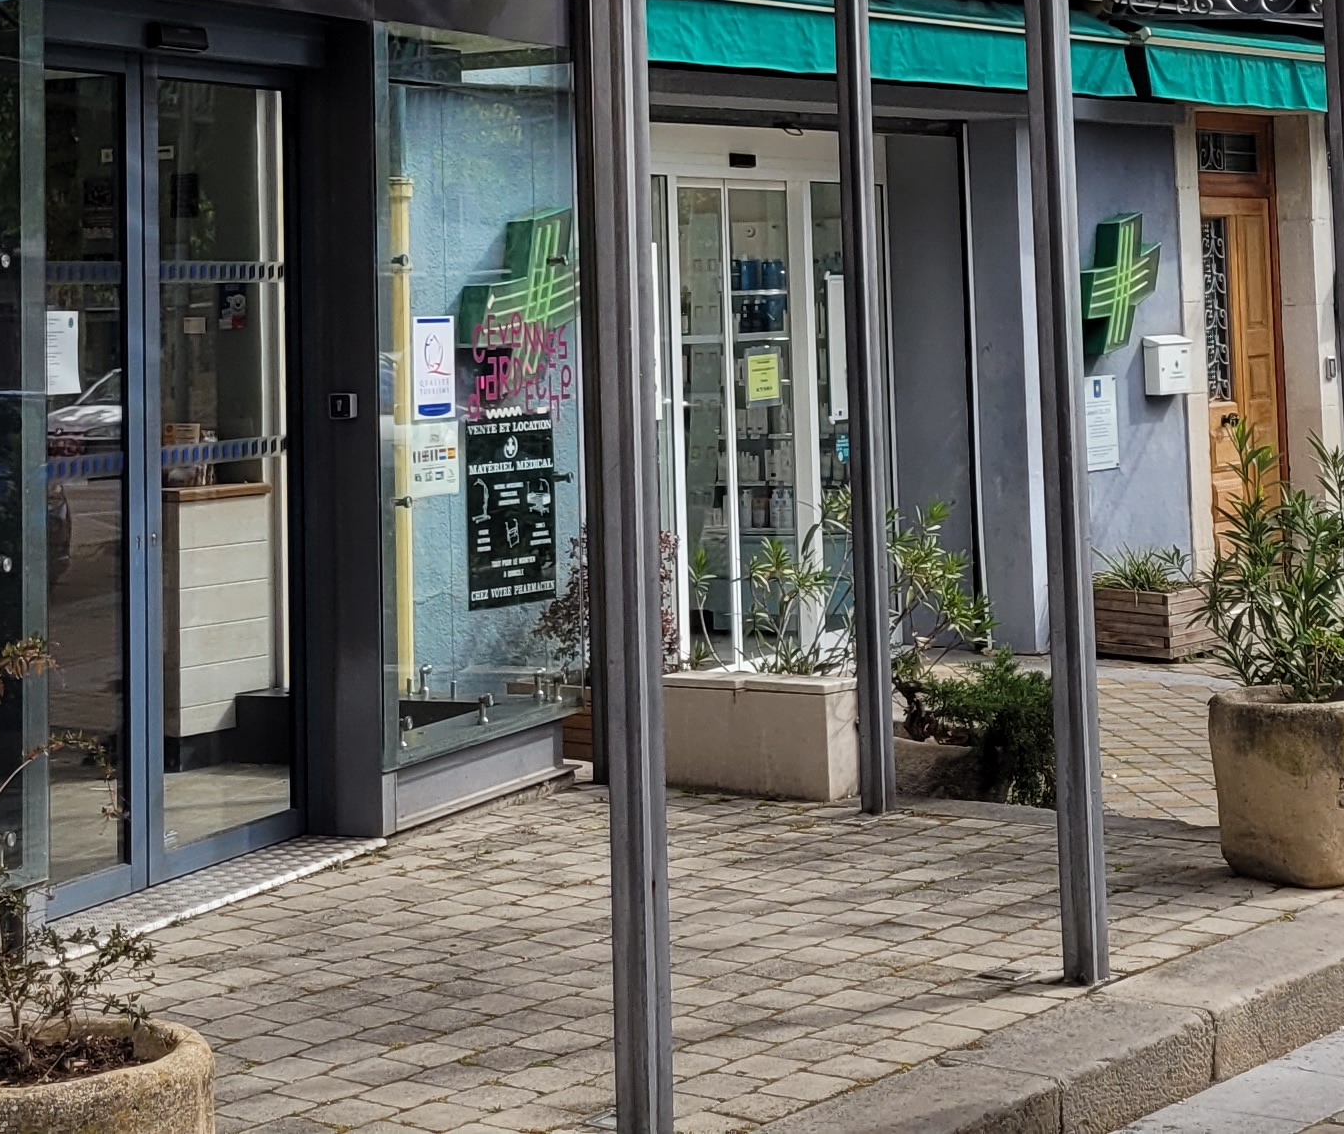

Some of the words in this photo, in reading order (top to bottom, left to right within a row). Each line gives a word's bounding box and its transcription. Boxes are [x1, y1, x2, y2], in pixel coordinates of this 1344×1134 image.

[467, 423, 497, 436] VENTE
[499, 422, 511, 433] ET
[512, 419, 552, 432] LOCATION
[469, 460, 514, 475] MATÉRIEL
[516, 457, 554, 471] MÉDICAL
[471, 589, 489, 602] CHEZ
[491, 586, 512, 598] VOTRE
[513, 580, 555, 595] PHARMACIEN
